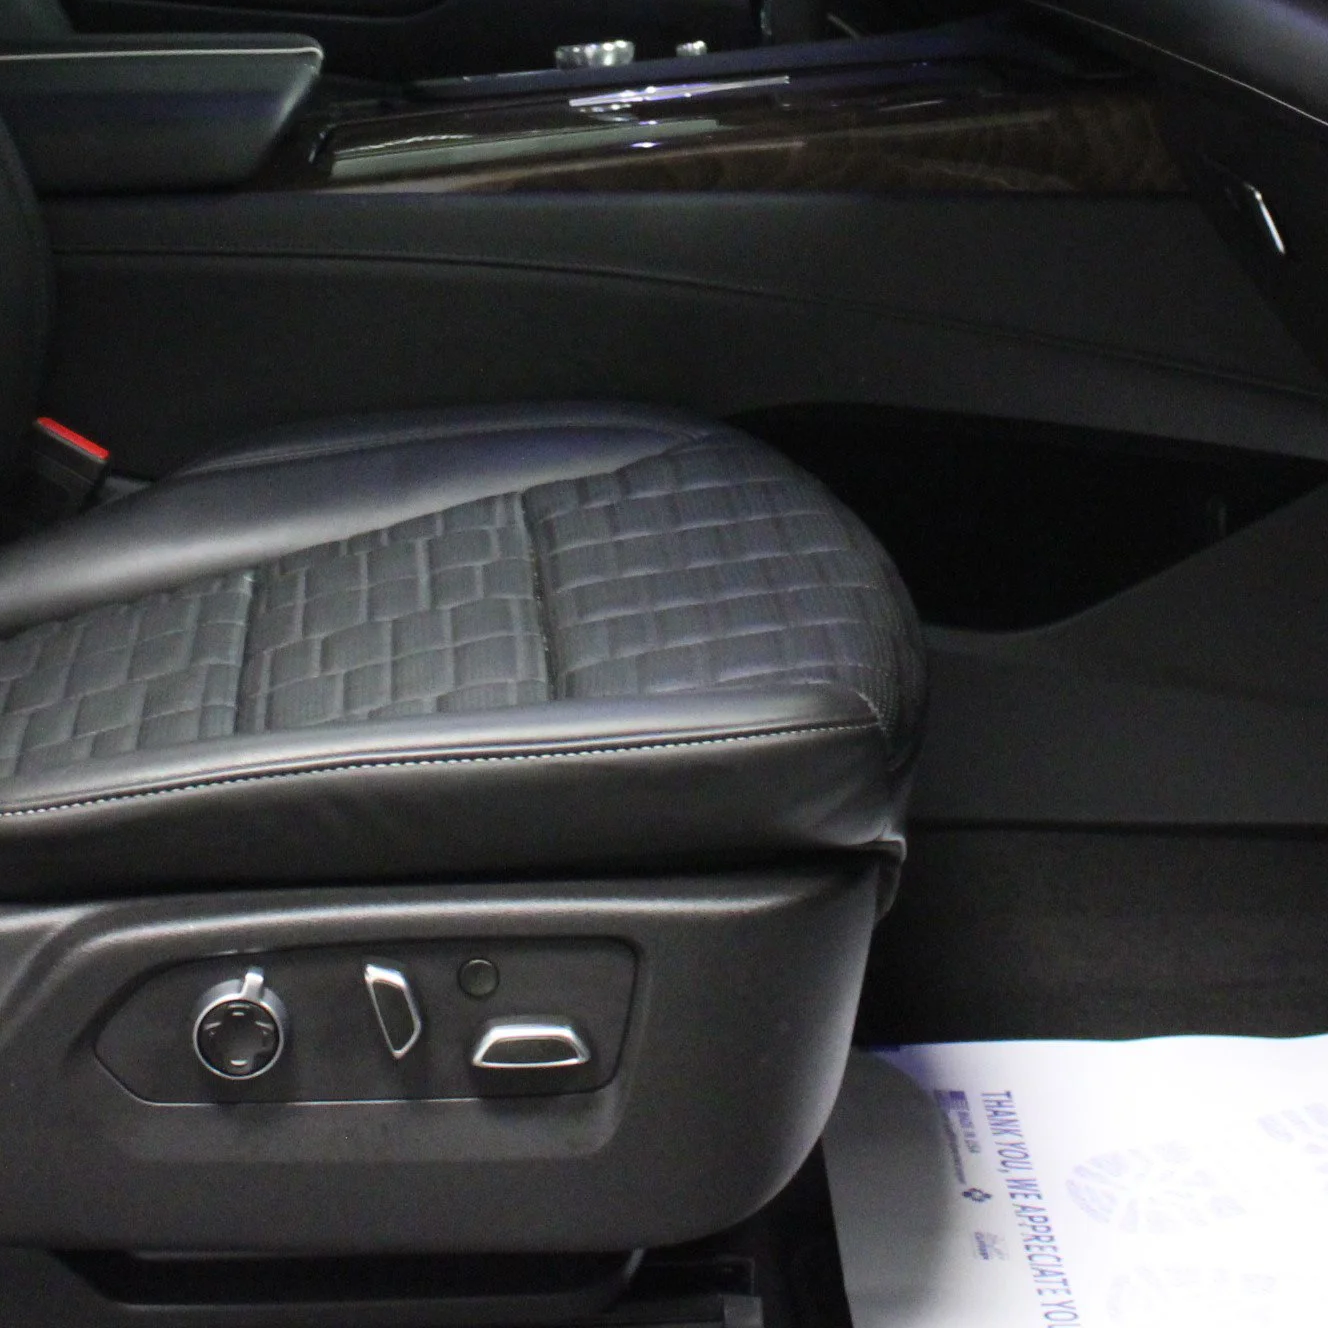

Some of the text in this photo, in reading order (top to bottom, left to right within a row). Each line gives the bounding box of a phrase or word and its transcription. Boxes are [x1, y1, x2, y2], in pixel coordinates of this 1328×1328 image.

[980, 1090, 1024, 1138] THANK
[994, 1141, 1034, 1173] YOU,
[1005, 1178, 1043, 1201] WE
[1012, 1203, 1072, 1296] APPRECIATE
